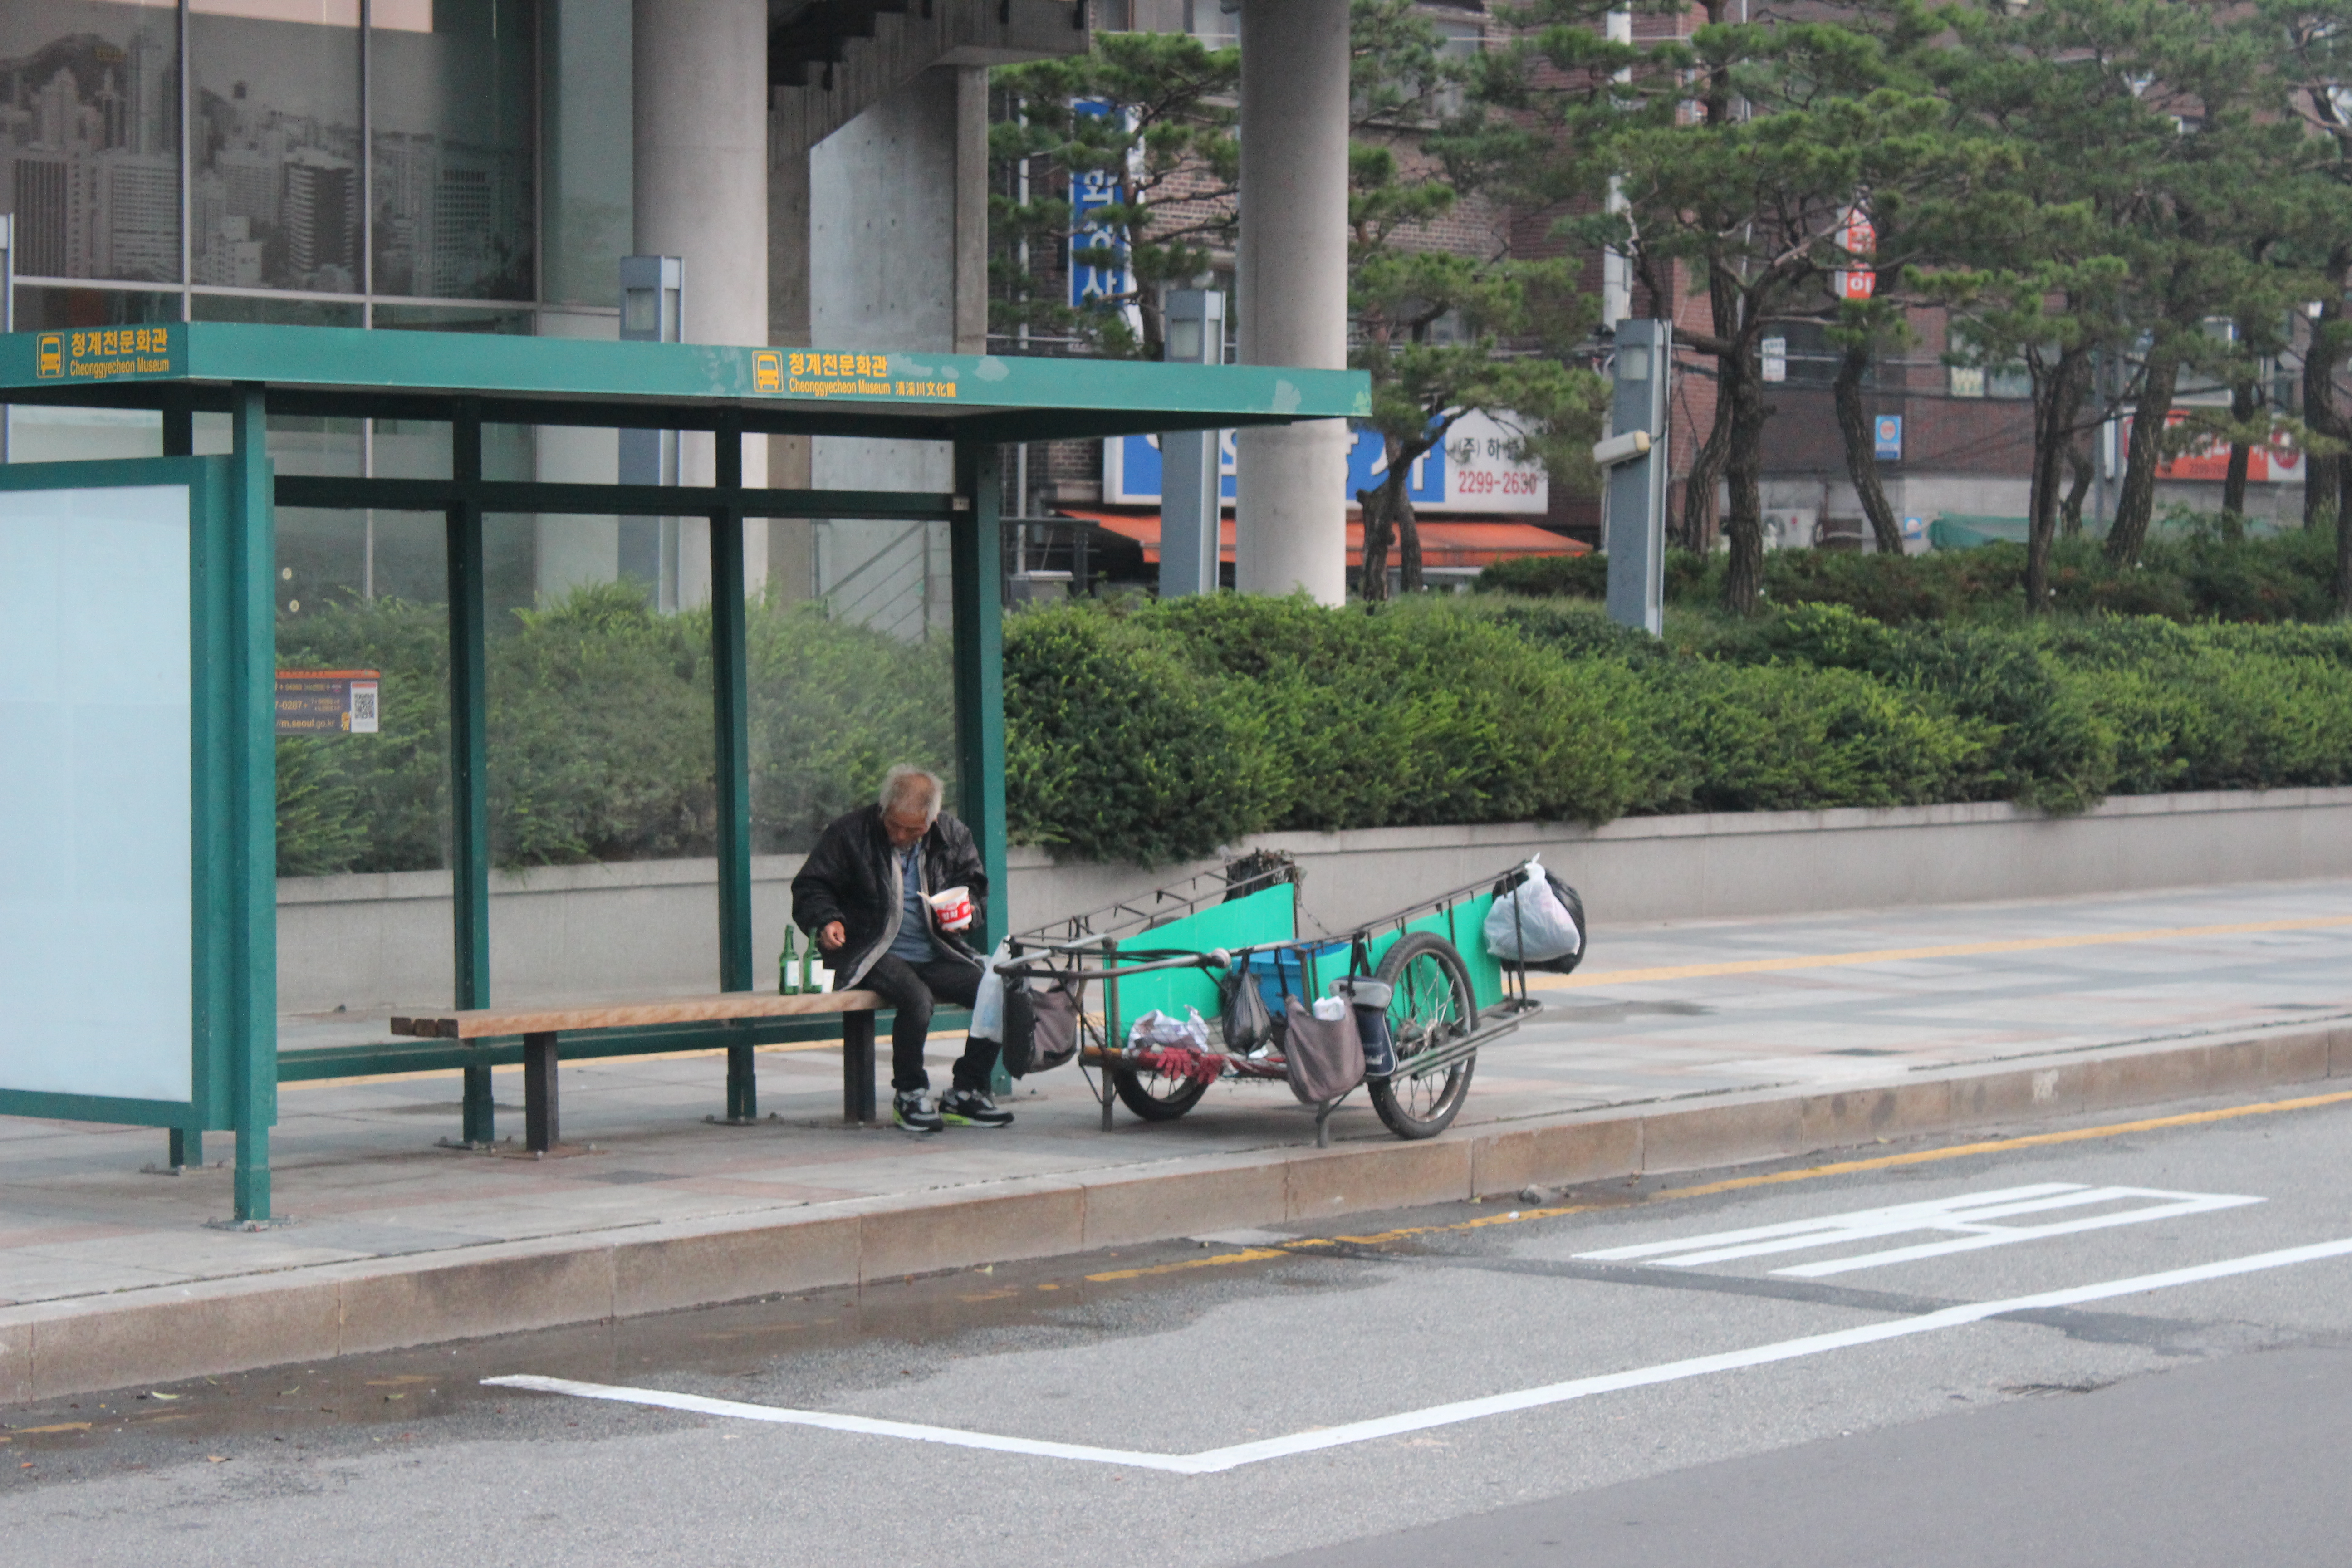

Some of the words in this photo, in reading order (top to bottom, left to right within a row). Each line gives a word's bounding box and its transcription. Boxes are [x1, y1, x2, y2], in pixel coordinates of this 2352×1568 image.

[71, 328, 168, 357] 청계천문화관
[70, 358, 135, 379] Cheonggyecheon
[137, 357, 169, 373] Museum
[789, 353, 887, 377] 청계천문화관
[789, 377, 857, 397] Cheonggyecheon
[858, 379, 891, 394] Museum
